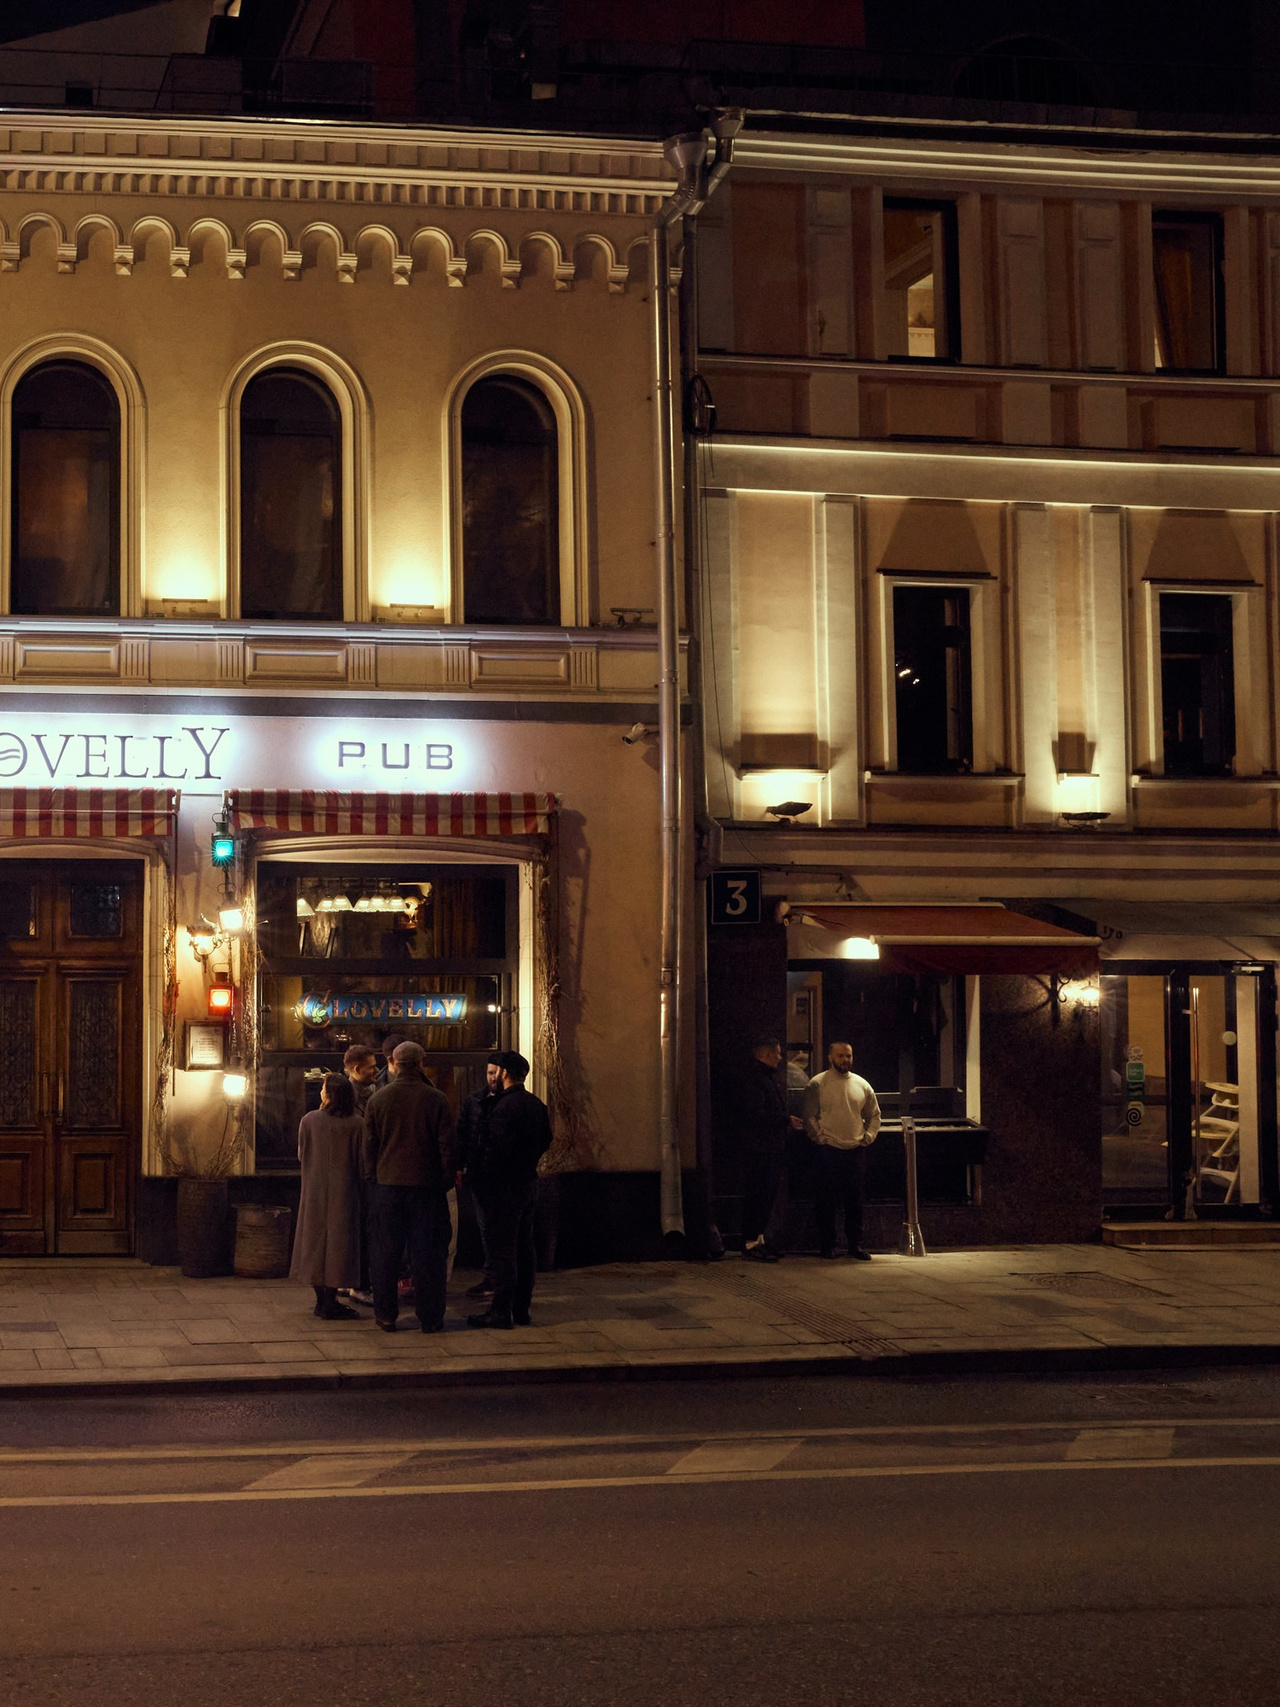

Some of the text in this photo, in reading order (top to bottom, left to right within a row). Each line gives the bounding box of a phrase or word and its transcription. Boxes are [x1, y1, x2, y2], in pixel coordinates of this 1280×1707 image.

[338, 741, 453, 770] PUB
[726, 880, 747, 915] 3
[293, 989, 458, 1028] CLOVELLY
